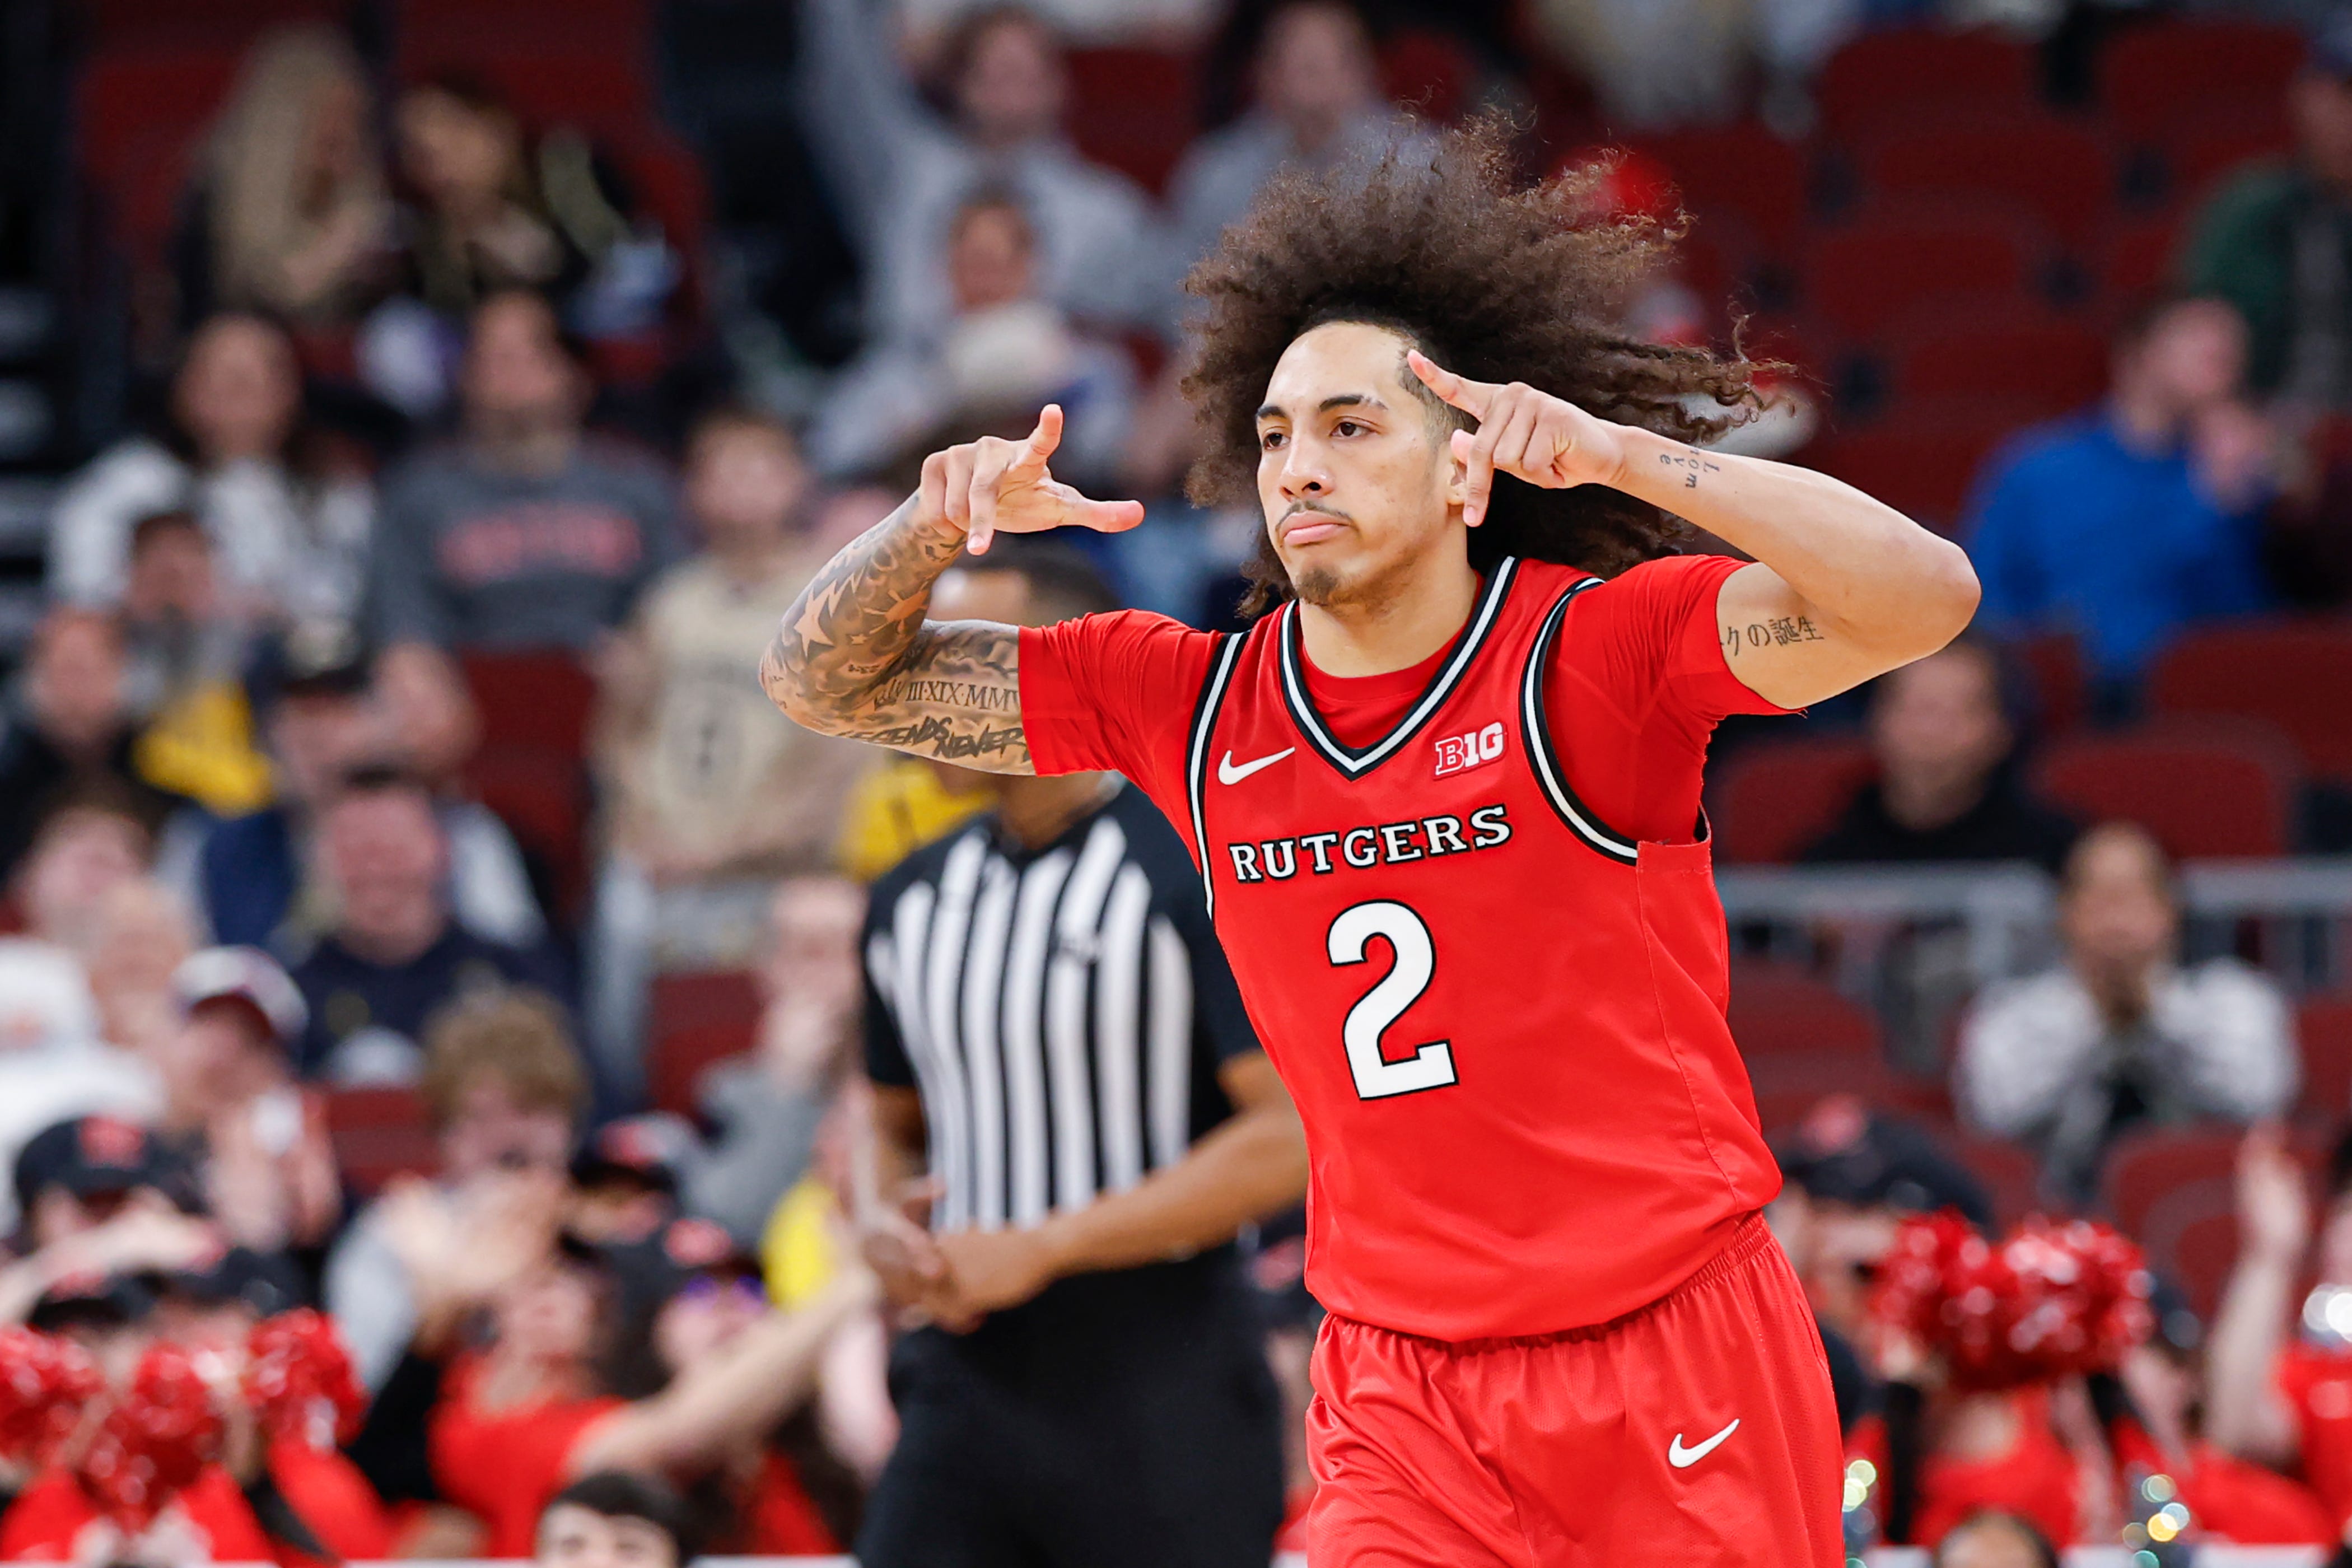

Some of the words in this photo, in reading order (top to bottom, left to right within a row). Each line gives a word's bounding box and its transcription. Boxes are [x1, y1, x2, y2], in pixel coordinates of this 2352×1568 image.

[1720, 615, 1824, 656] クの誕生
[1228, 802, 1514, 883] RUTGERS
[1326, 899, 1459, 1100] 2
